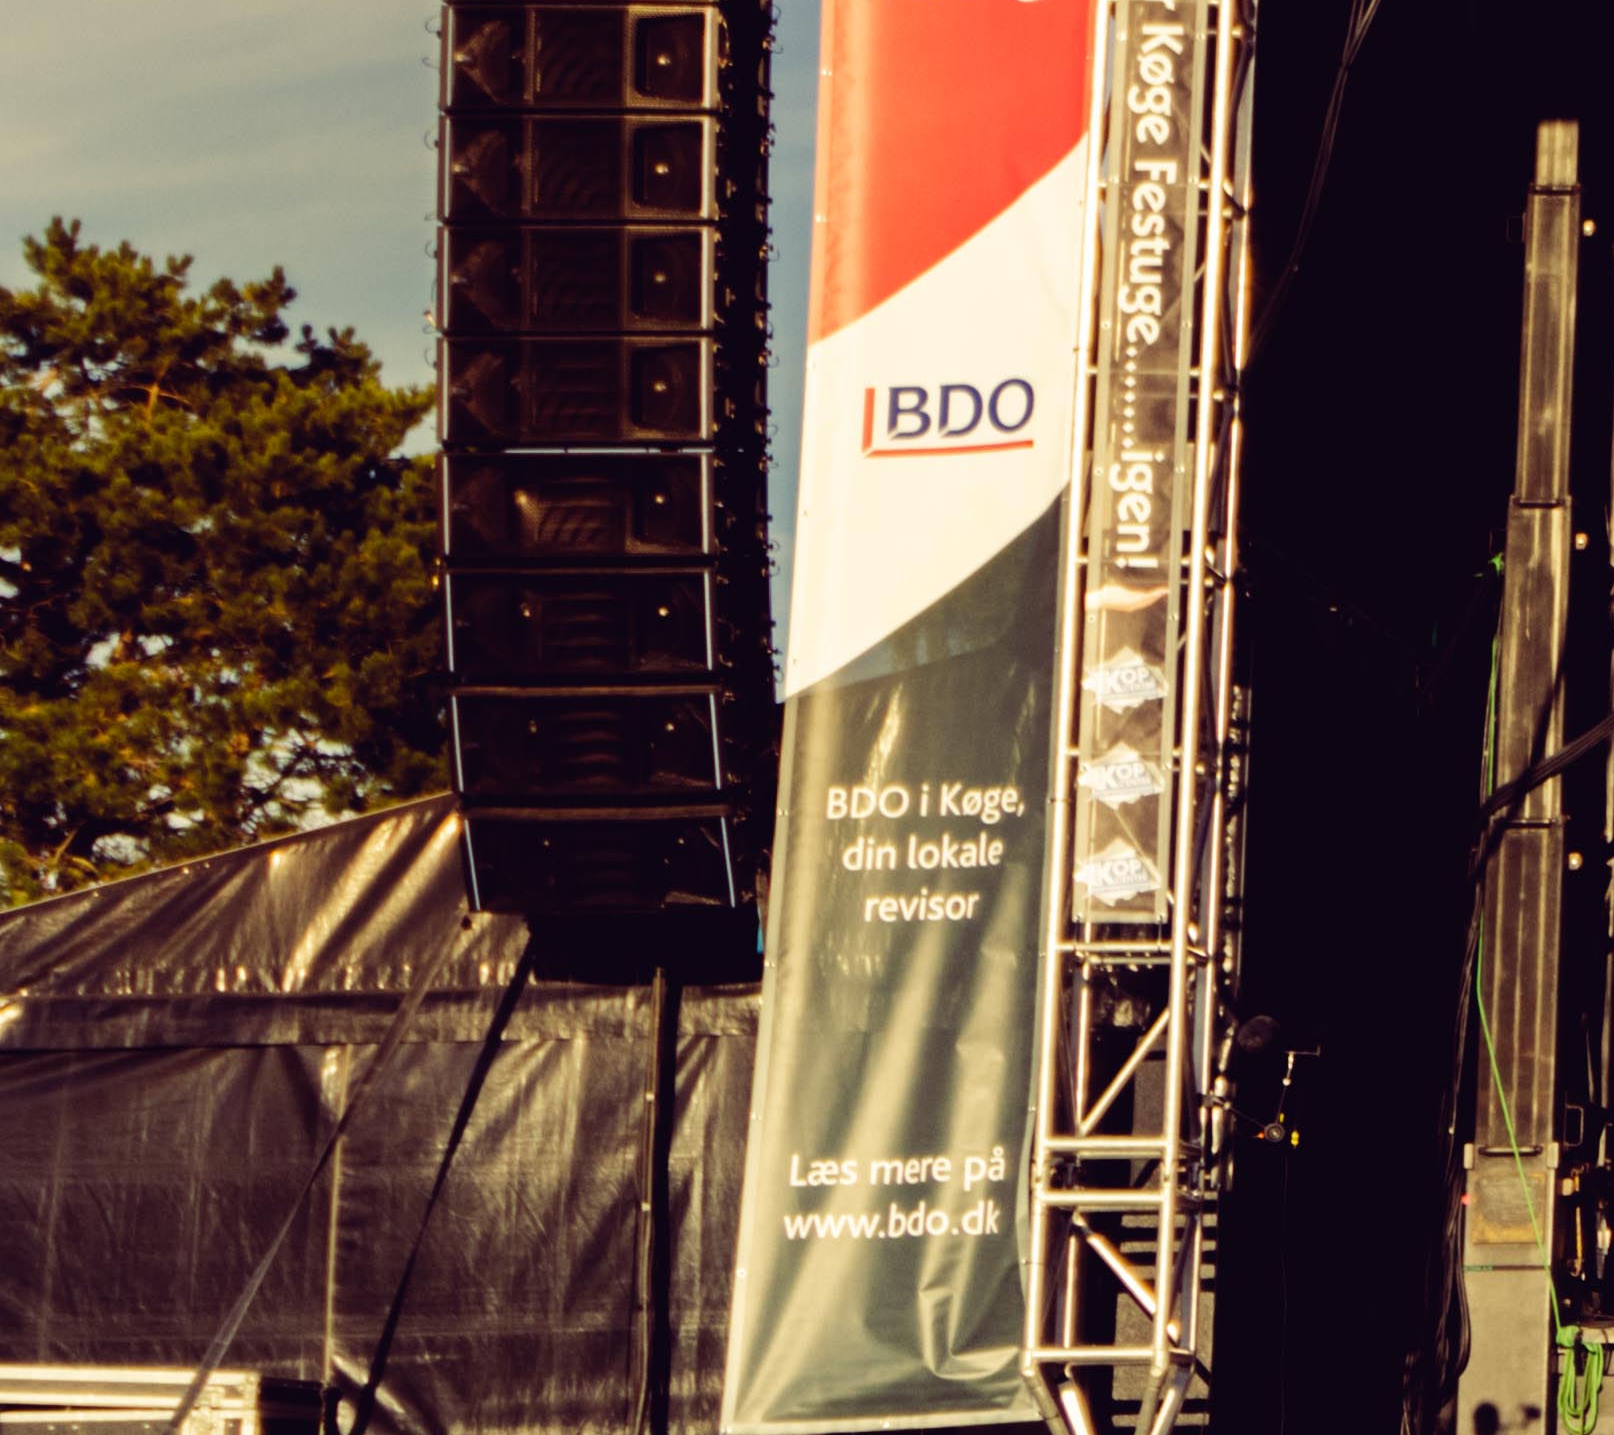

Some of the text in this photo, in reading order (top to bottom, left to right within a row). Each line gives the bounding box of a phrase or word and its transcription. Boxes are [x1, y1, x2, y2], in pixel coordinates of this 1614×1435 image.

[1127, 22, 1184, 146] Køge
[888, 377, 1036, 438] BDO
[826, 783, 1026, 827] BDO i Køge,
[842, 831, 1004, 872] din lokale
[863, 887, 981, 924] revisor
[788, 1145, 1008, 1195] Læs mere på
[782, 1199, 1000, 1239] www.bdo.dk
